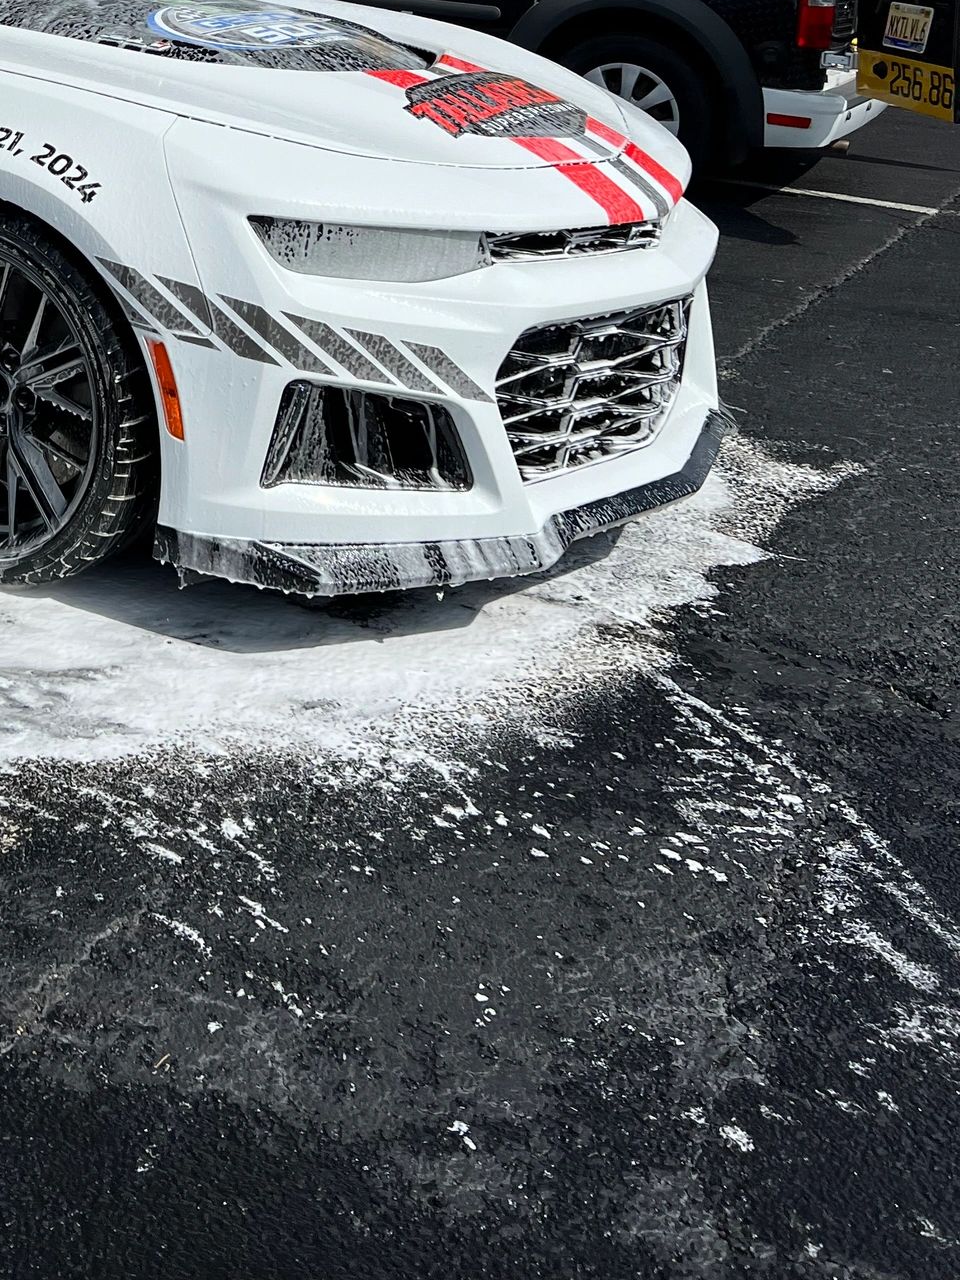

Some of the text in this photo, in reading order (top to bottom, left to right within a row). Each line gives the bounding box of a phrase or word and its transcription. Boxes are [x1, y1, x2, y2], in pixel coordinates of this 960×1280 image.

[240, 21, 339, 45] 500
[889, 61, 954, 109] 256.86
[29, 143, 102, 204] 2024
